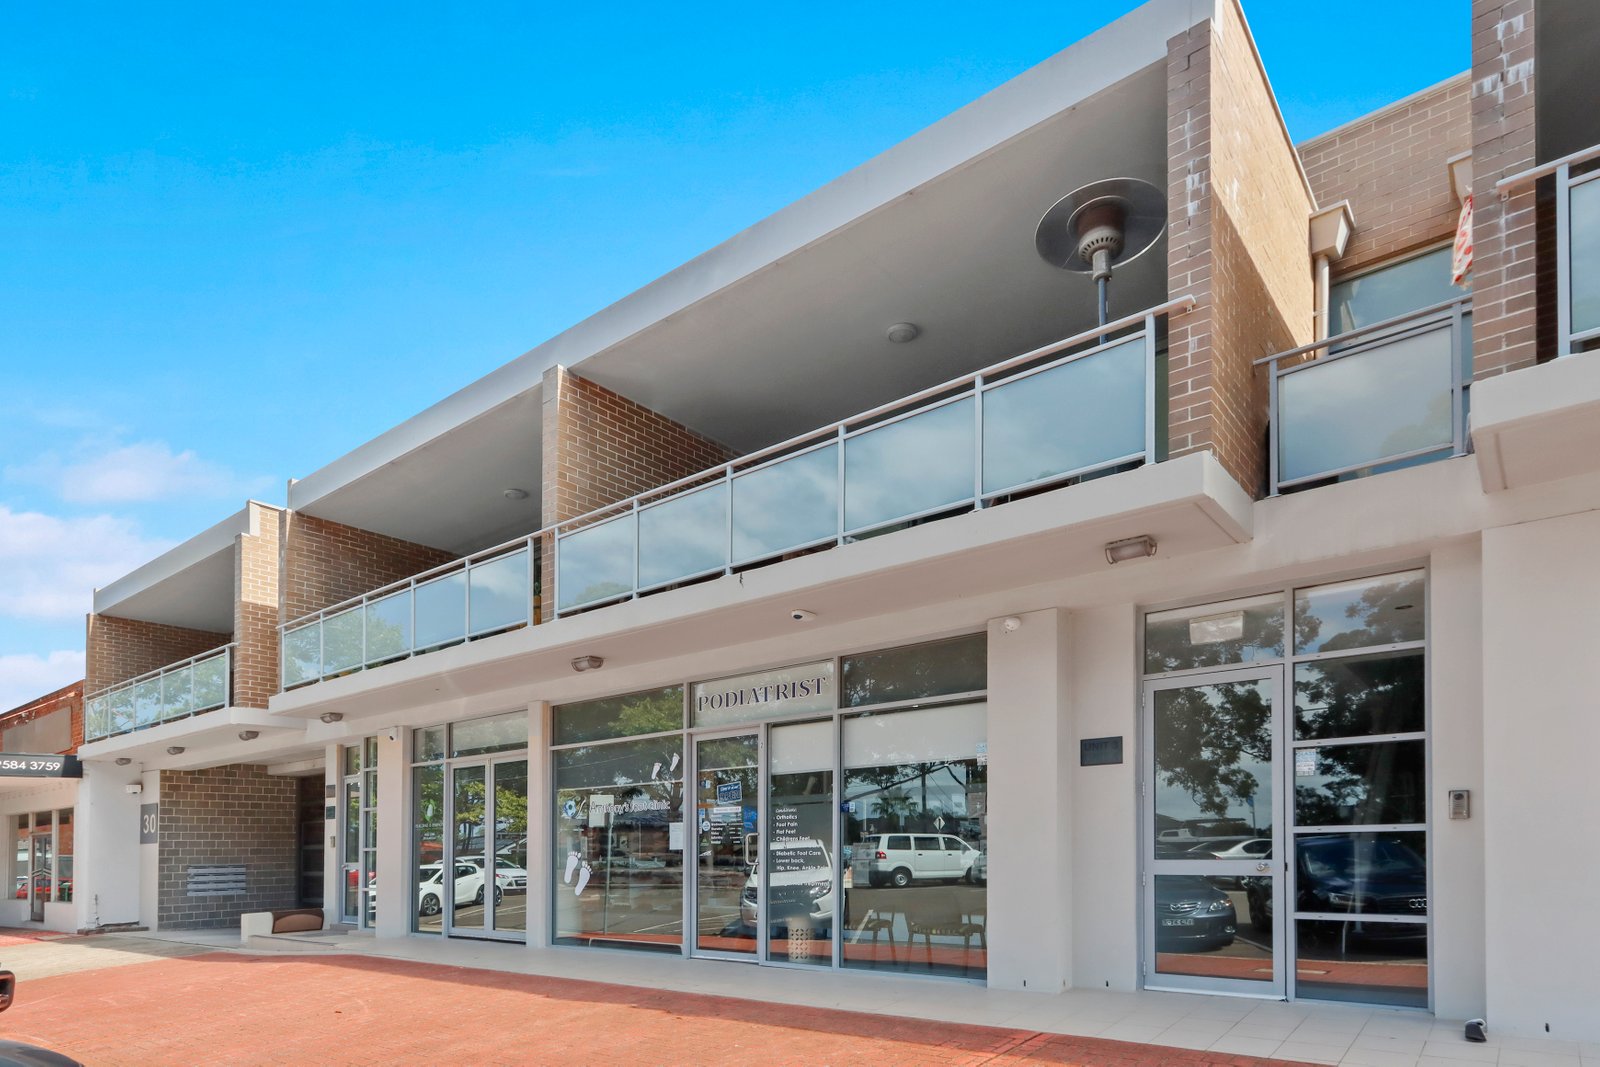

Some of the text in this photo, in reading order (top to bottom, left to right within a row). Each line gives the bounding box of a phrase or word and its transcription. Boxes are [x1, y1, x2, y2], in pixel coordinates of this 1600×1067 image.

[698, 677, 826, 712] PODIATRIST
[0, 760, 61, 771] 584 3759
[143, 814, 156, 834] 30
